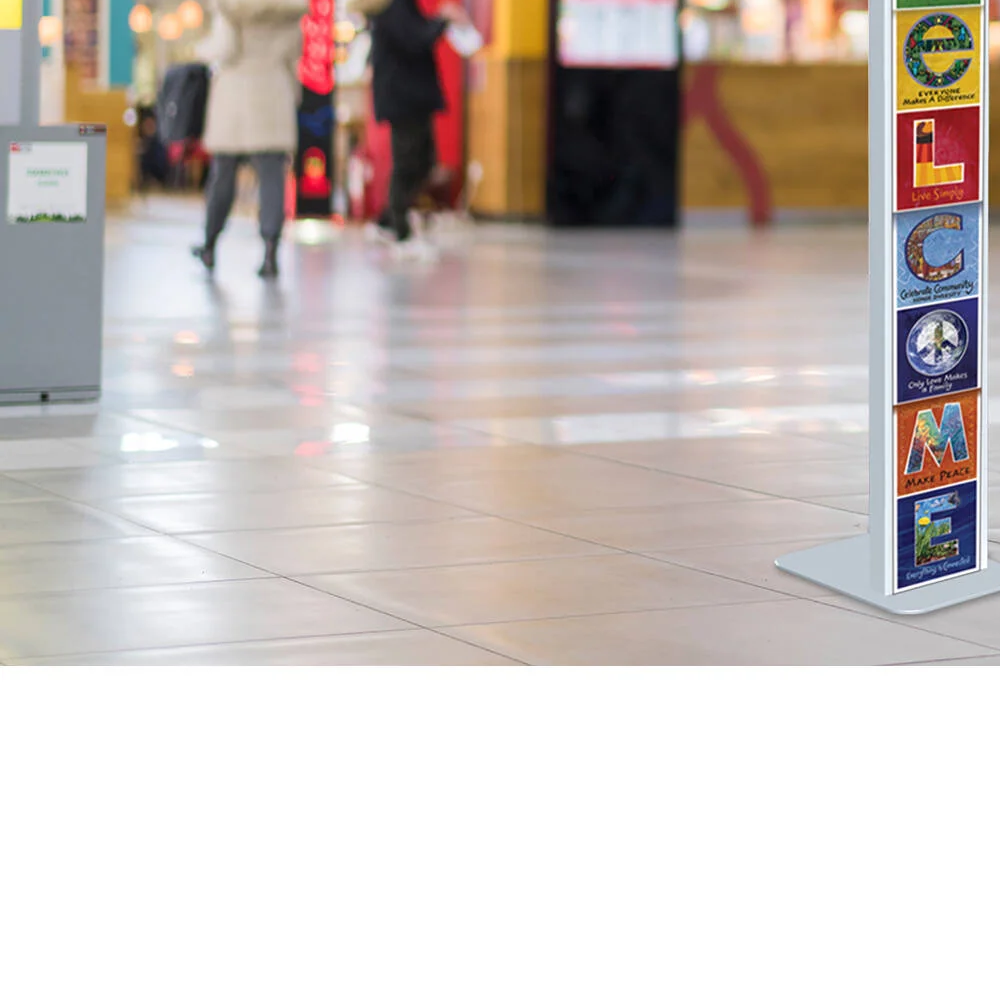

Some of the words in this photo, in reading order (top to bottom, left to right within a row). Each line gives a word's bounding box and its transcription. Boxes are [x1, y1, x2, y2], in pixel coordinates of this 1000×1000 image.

[913, 118, 965, 188] L
[911, 191, 931, 202] Live
[933, 185, 965, 201] Simply
[904, 212, 965, 283] C
[900, 286, 933, 301] Celebrate
[933, 279, 974, 295] Community
[907, 380, 926, 390] Only
[926, 377, 943, 386] Love
[943, 372, 968, 382] Makes
[904, 401, 970, 476] M
[905, 475, 935, 488] MAKE
[939, 467, 970, 480] PEACE
[914, 490, 961, 568] E
